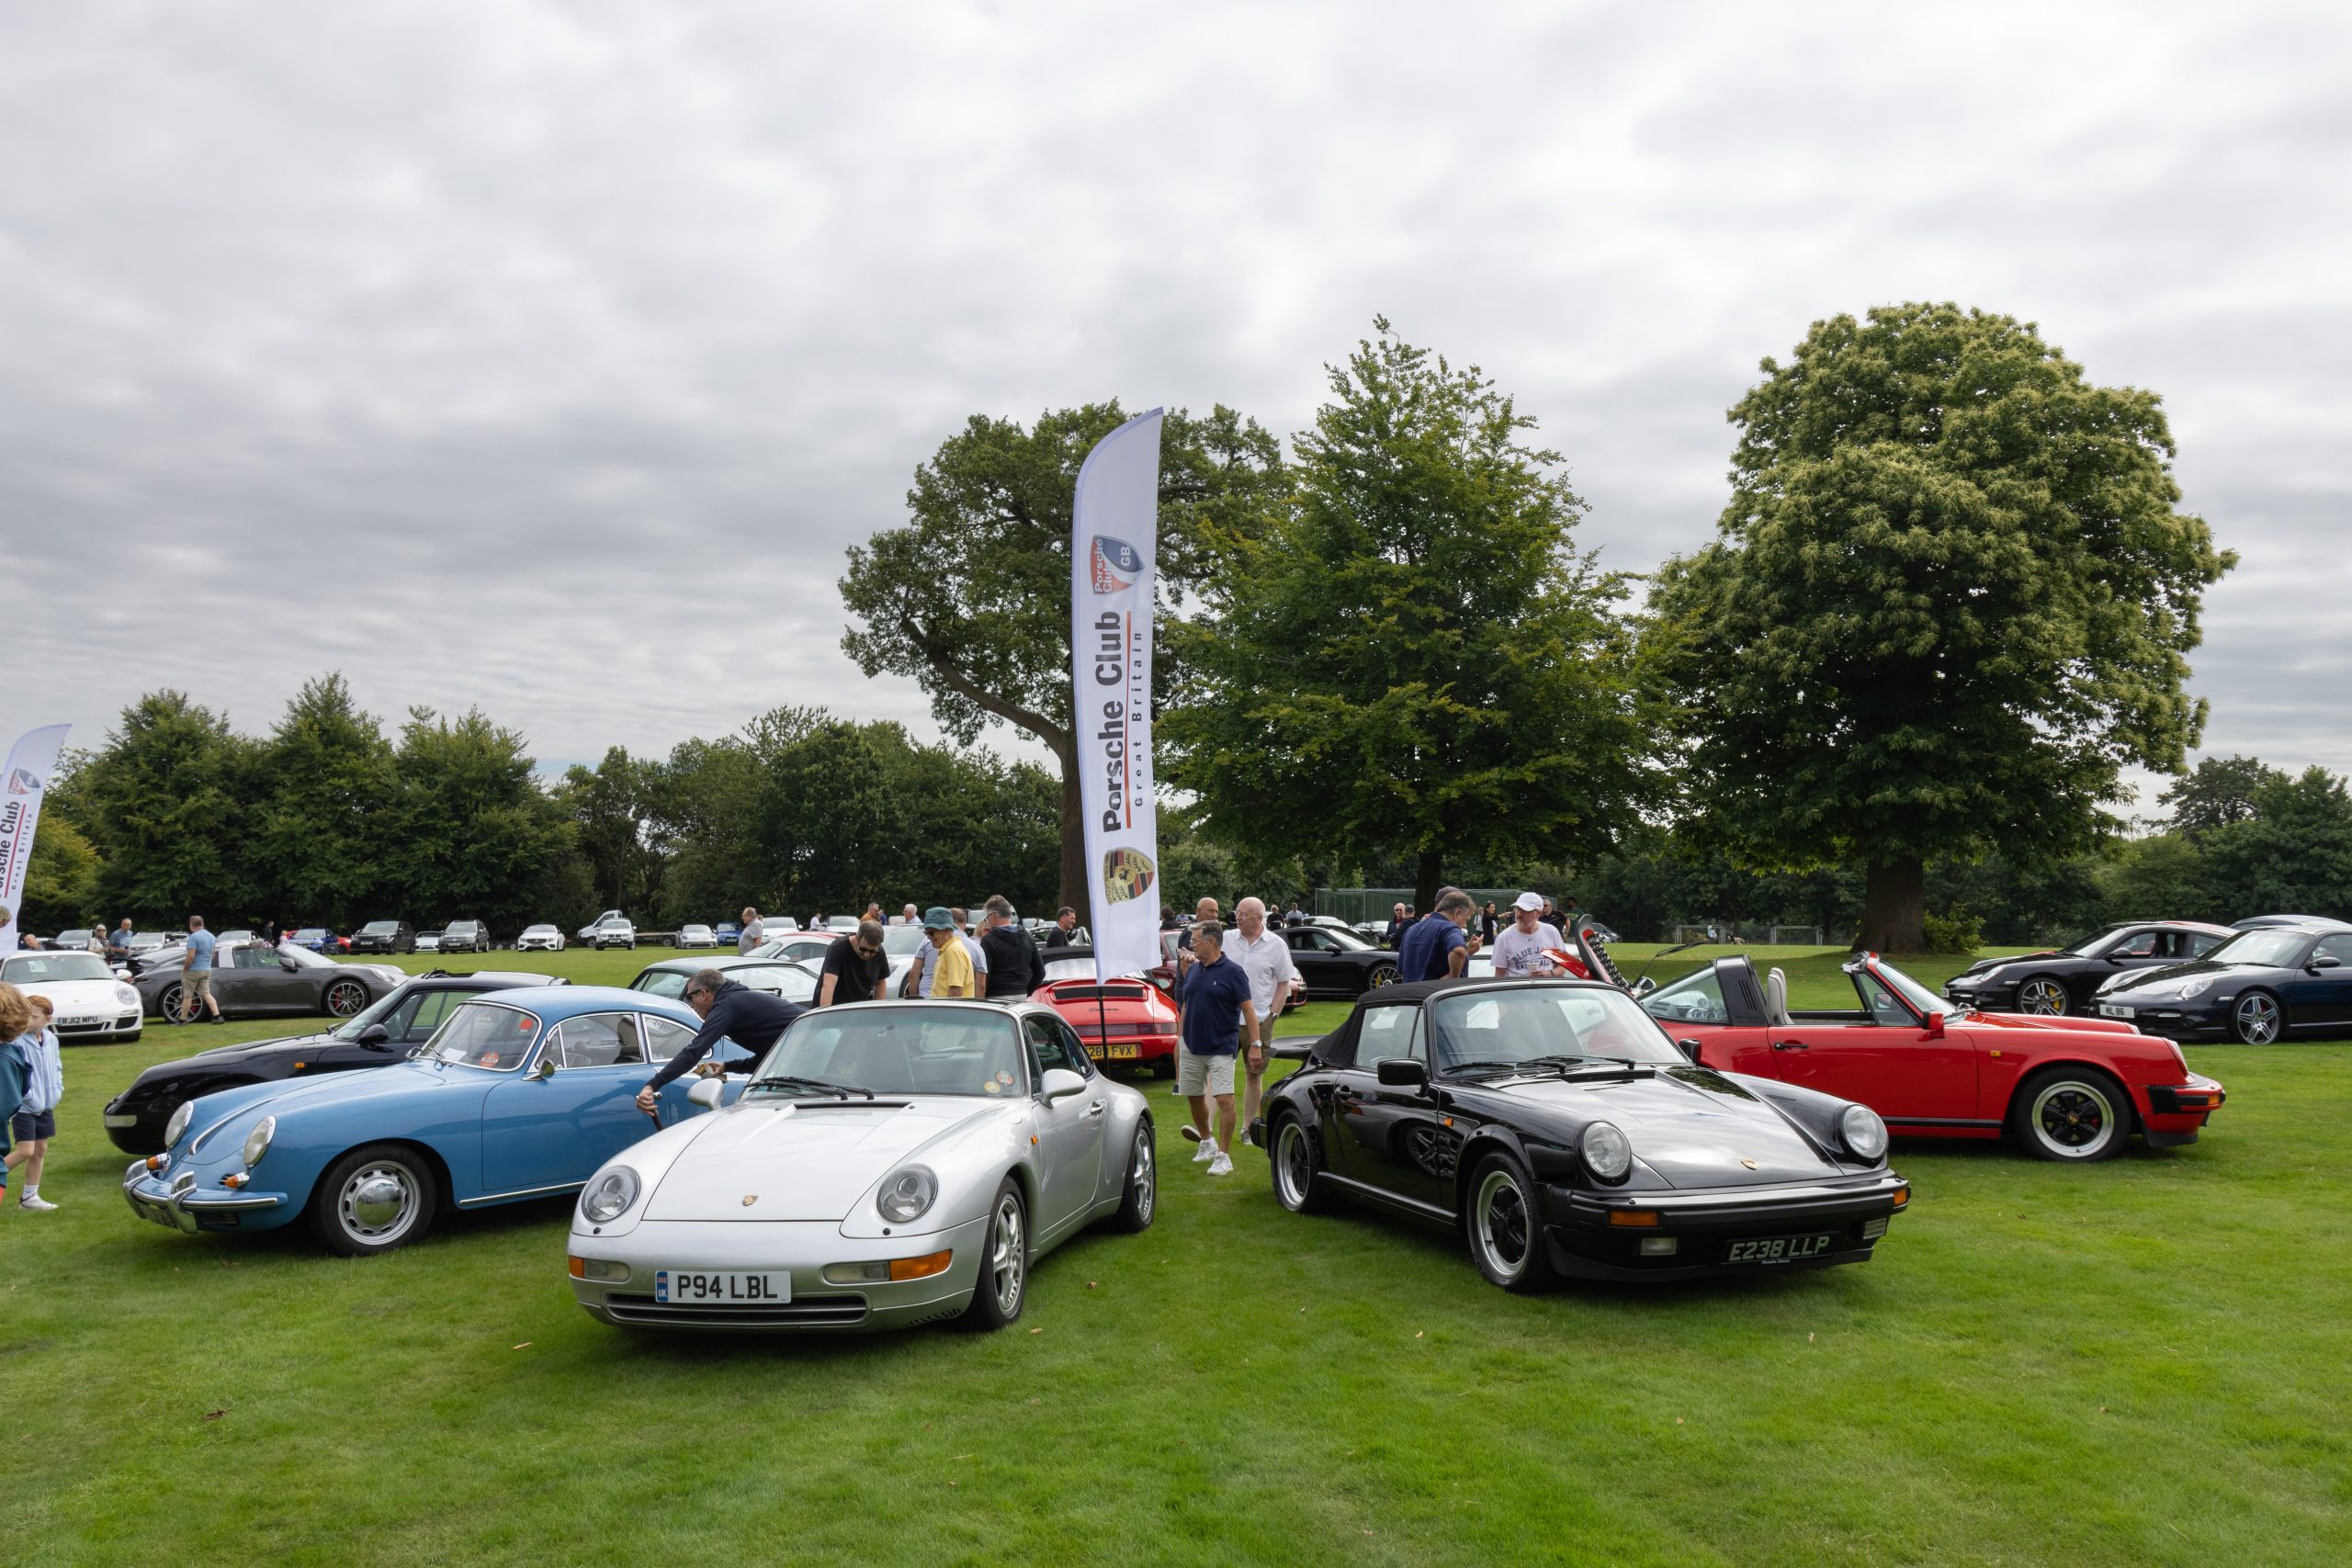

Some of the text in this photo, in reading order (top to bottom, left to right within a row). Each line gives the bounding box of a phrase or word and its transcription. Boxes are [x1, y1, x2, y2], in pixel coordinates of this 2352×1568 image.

[1094, 538, 1103, 592] Porsche
[1120, 547, 1131, 567] GB
[1095, 612, 1124, 832] Porsche Club
[1131, 633, 1143, 807] Great Britain
[0, 801, 19, 834] Club
[0, 840, 11, 897] sche
[1112, 1046, 1132, 1056] FVX
[1728, 1235, 1830, 1261] E238 LLP
[658, 1289, 667, 1297] UK
[677, 1275, 778, 1299] P94 LBL
